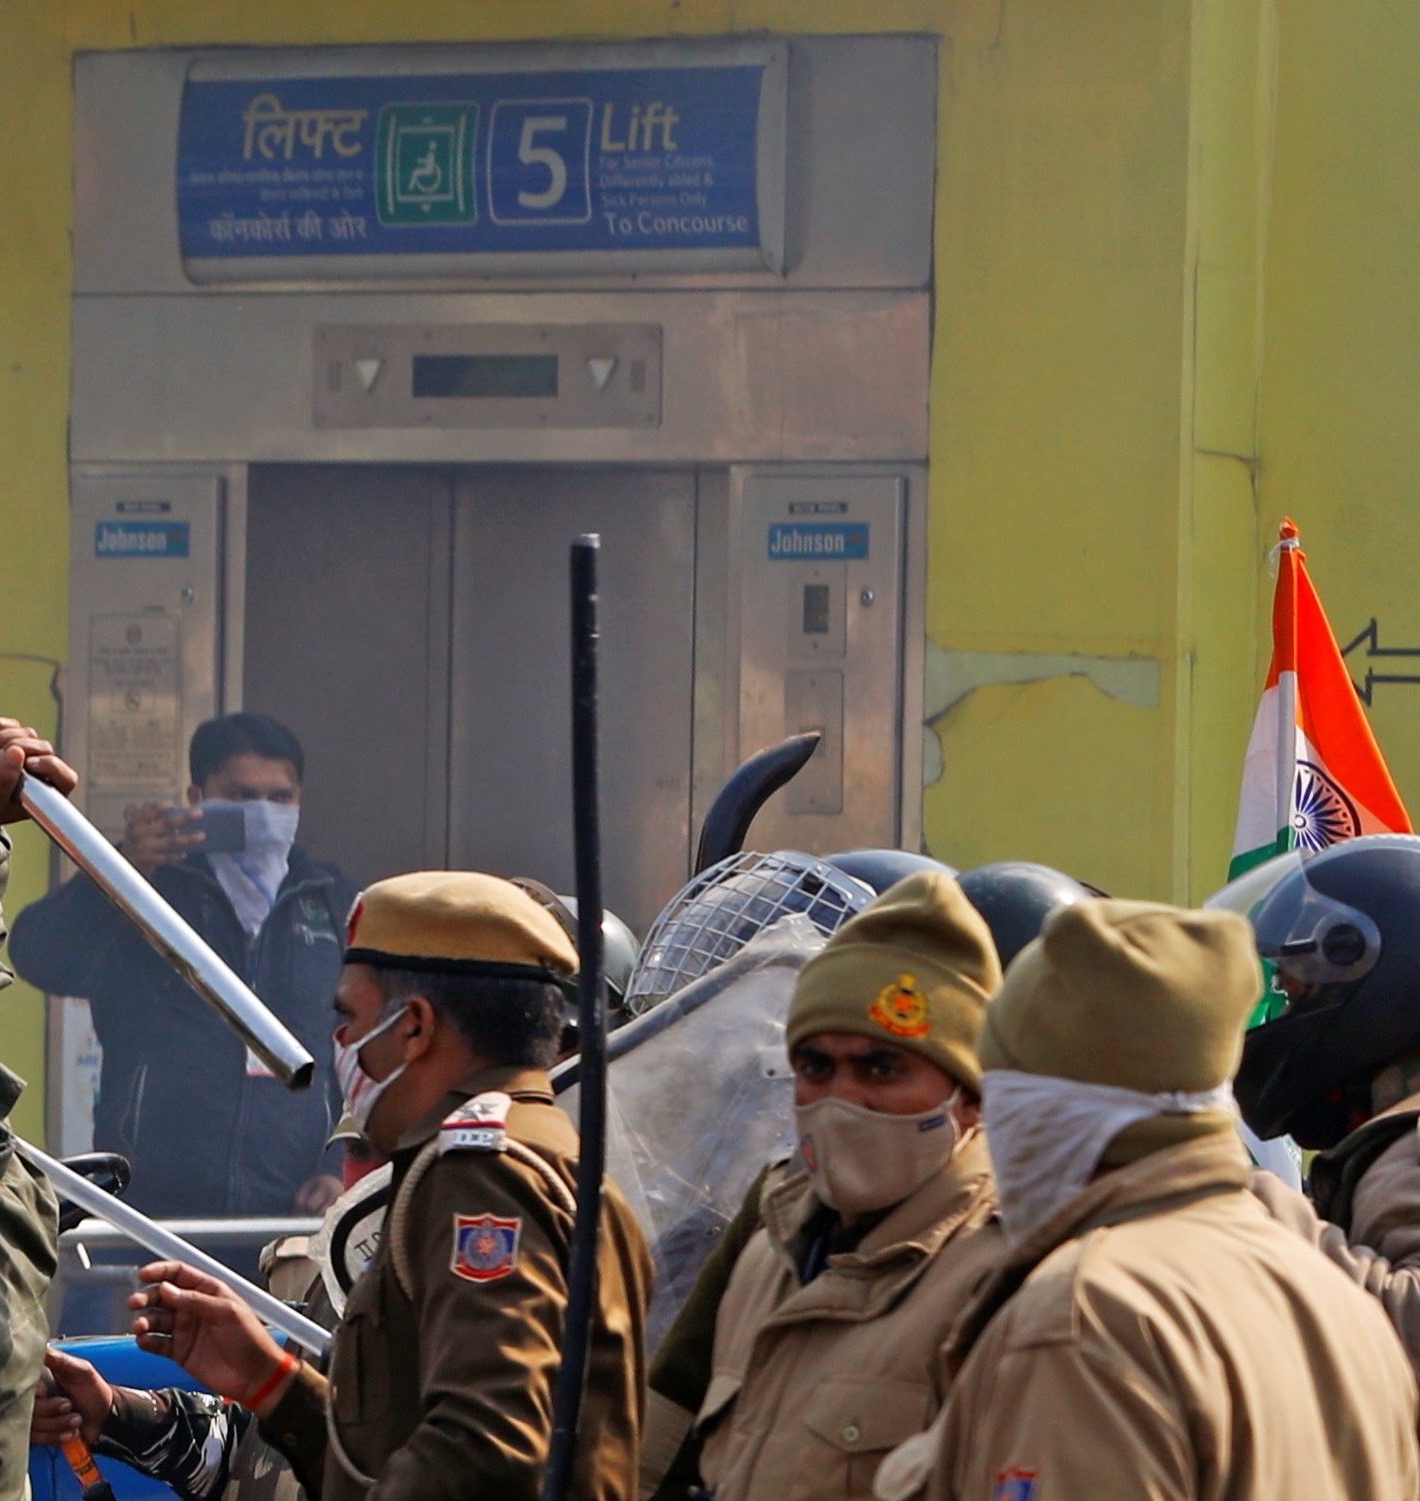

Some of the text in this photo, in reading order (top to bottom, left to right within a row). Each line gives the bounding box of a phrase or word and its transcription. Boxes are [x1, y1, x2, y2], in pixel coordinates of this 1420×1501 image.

[241, 94, 370, 160] लिफ्ट
[600, 101, 680, 151] Lift
[516, 116, 568, 209] 5
[295, 210, 322, 240] की
[328, 209, 367, 240] ओर
[604, 210, 749, 235] To Concourse
[97, 526, 168, 552] Johnson
[771, 527, 845, 553] Johnson
